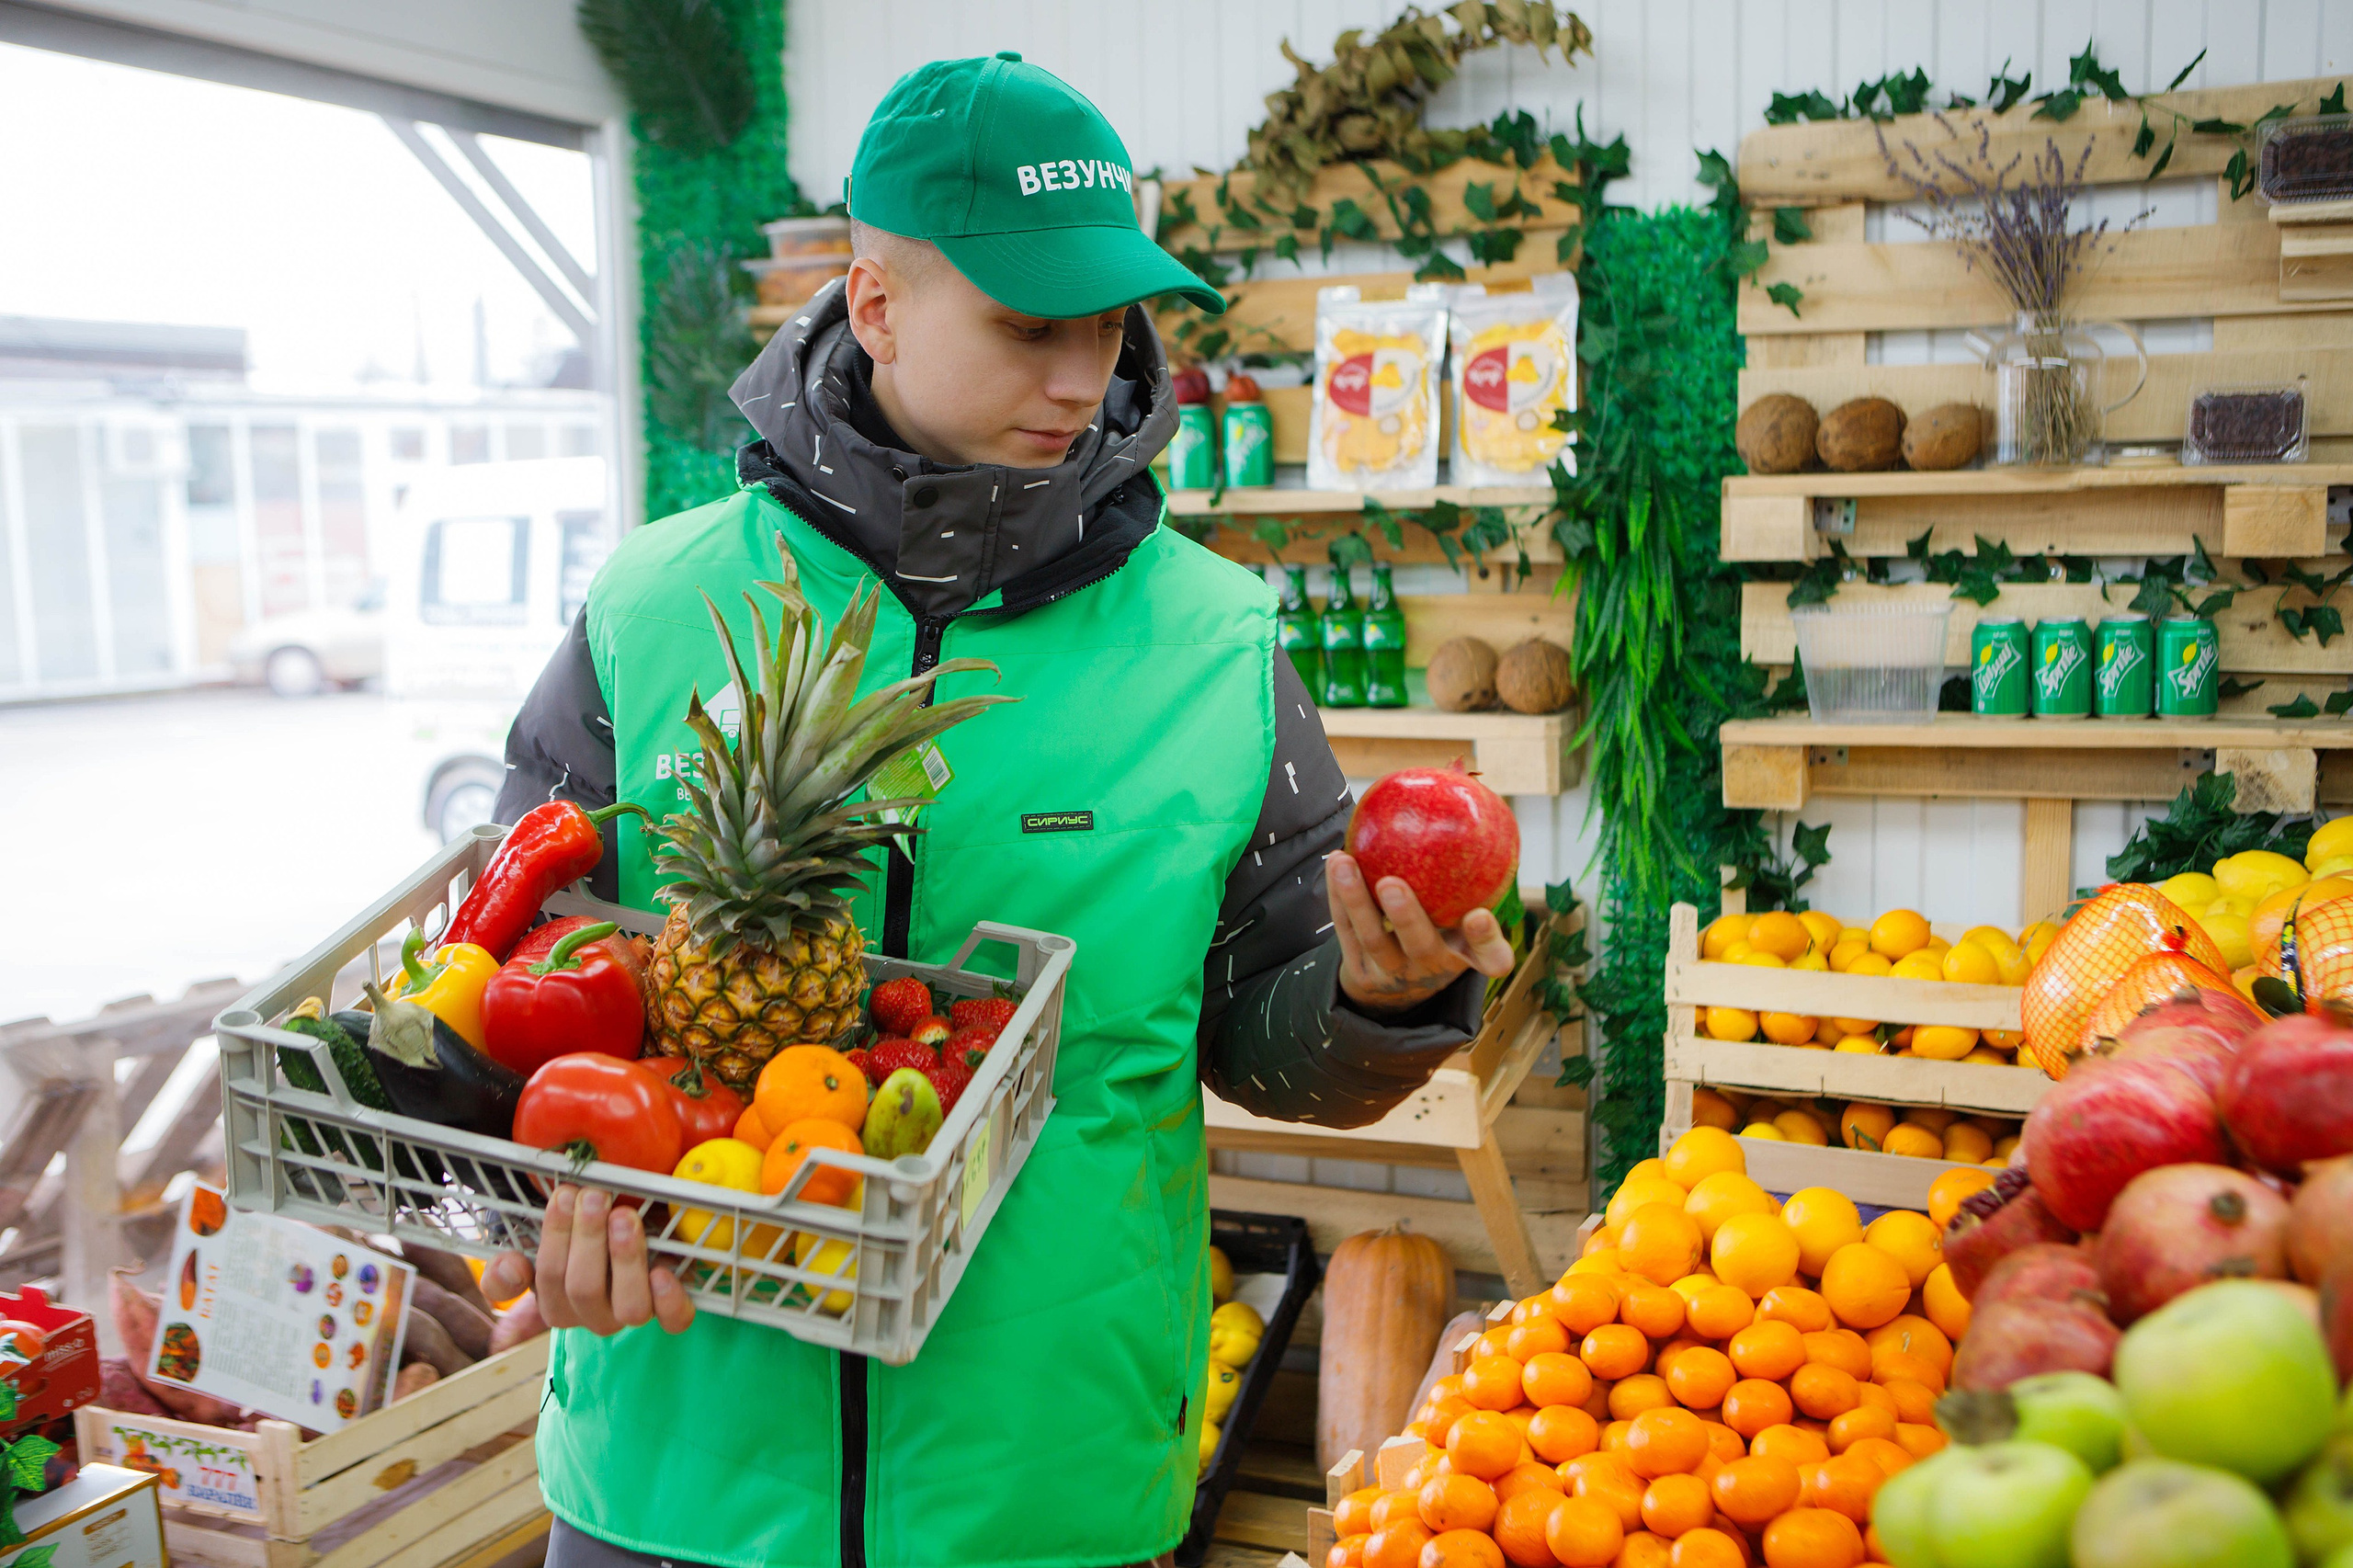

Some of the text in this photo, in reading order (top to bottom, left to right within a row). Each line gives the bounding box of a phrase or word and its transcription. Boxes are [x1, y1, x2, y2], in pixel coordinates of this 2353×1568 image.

[2040, 643, 2078, 697] Sprite
[2099, 643, 2135, 697] Sprite
[2177, 642, 2214, 698] Sprite
[1027, 815, 1088, 827] СИРИУС
[199, 1466, 238, 1492] 777
